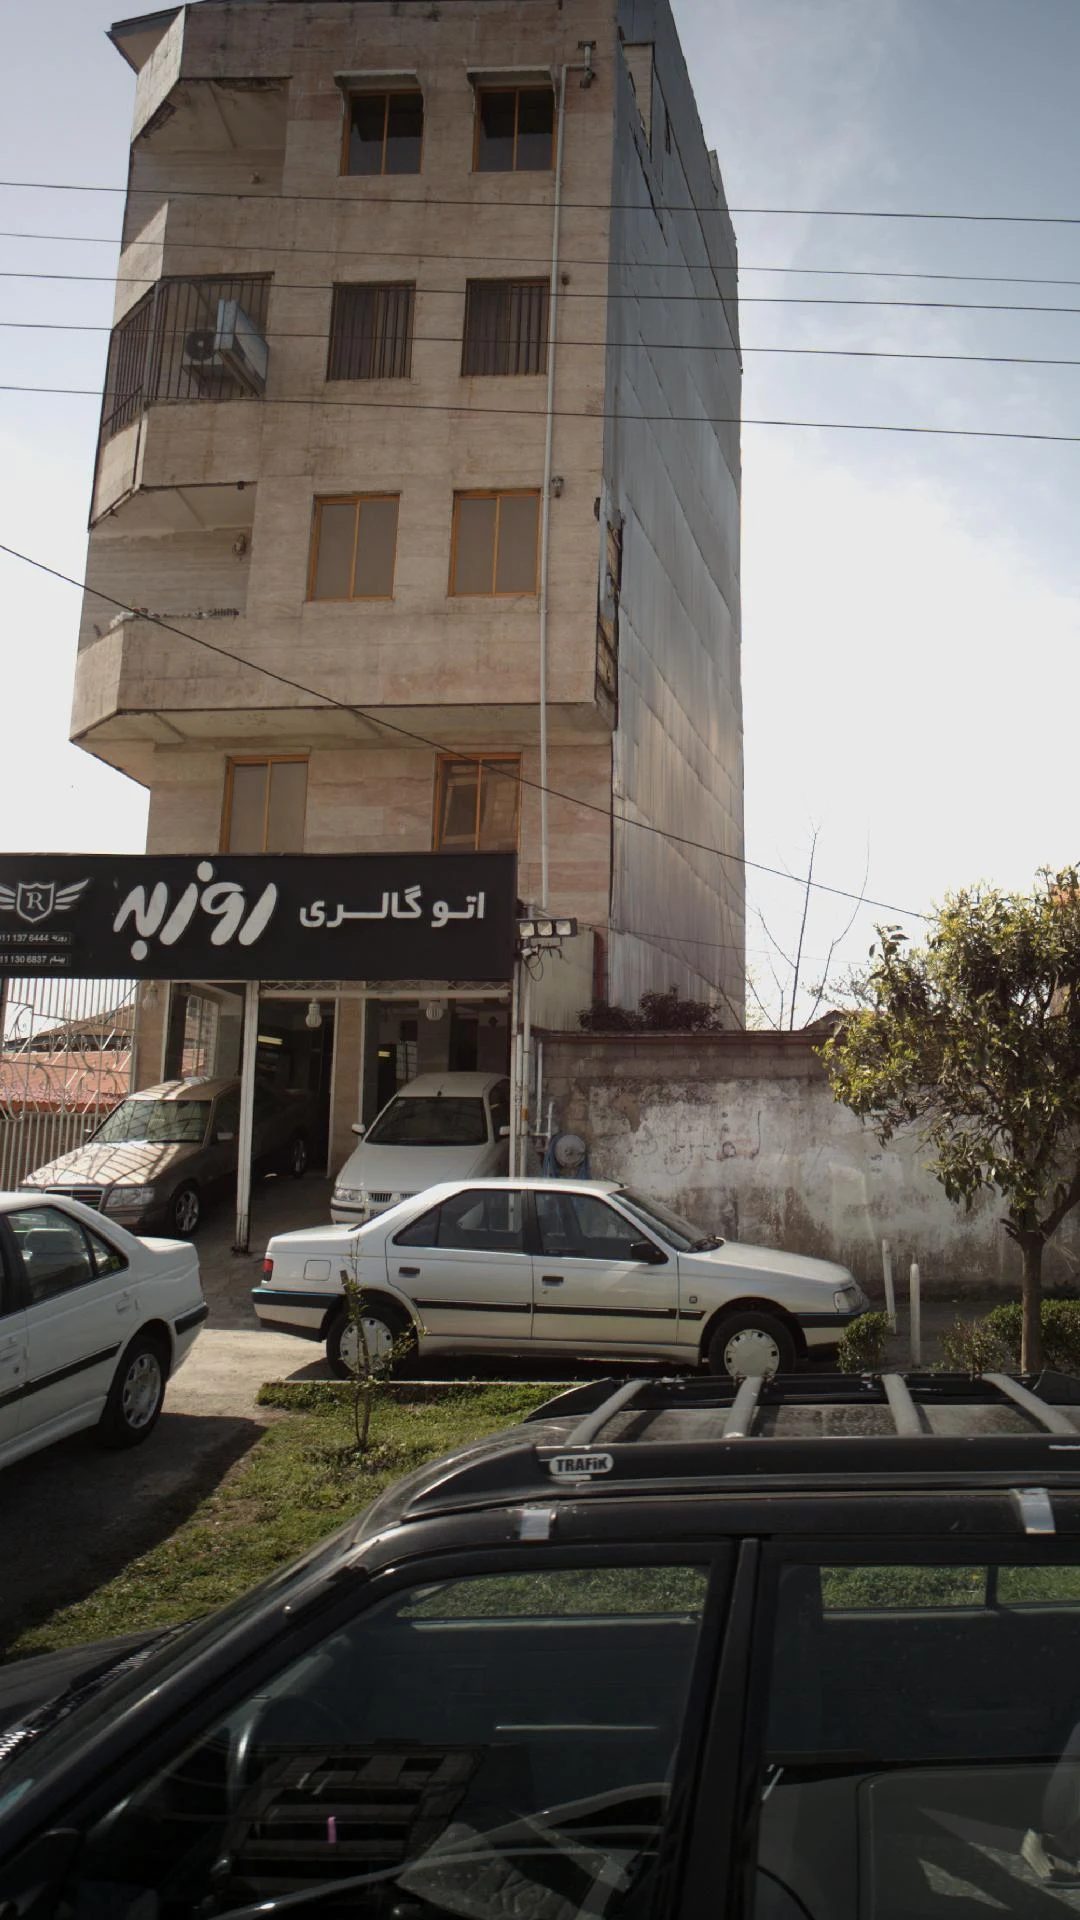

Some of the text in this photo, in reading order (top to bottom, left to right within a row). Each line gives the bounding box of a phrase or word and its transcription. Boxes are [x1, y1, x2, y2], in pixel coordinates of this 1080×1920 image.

[26, 892, 45, 911] R
[112, 860, 486, 961] اتو گالری روزبه
